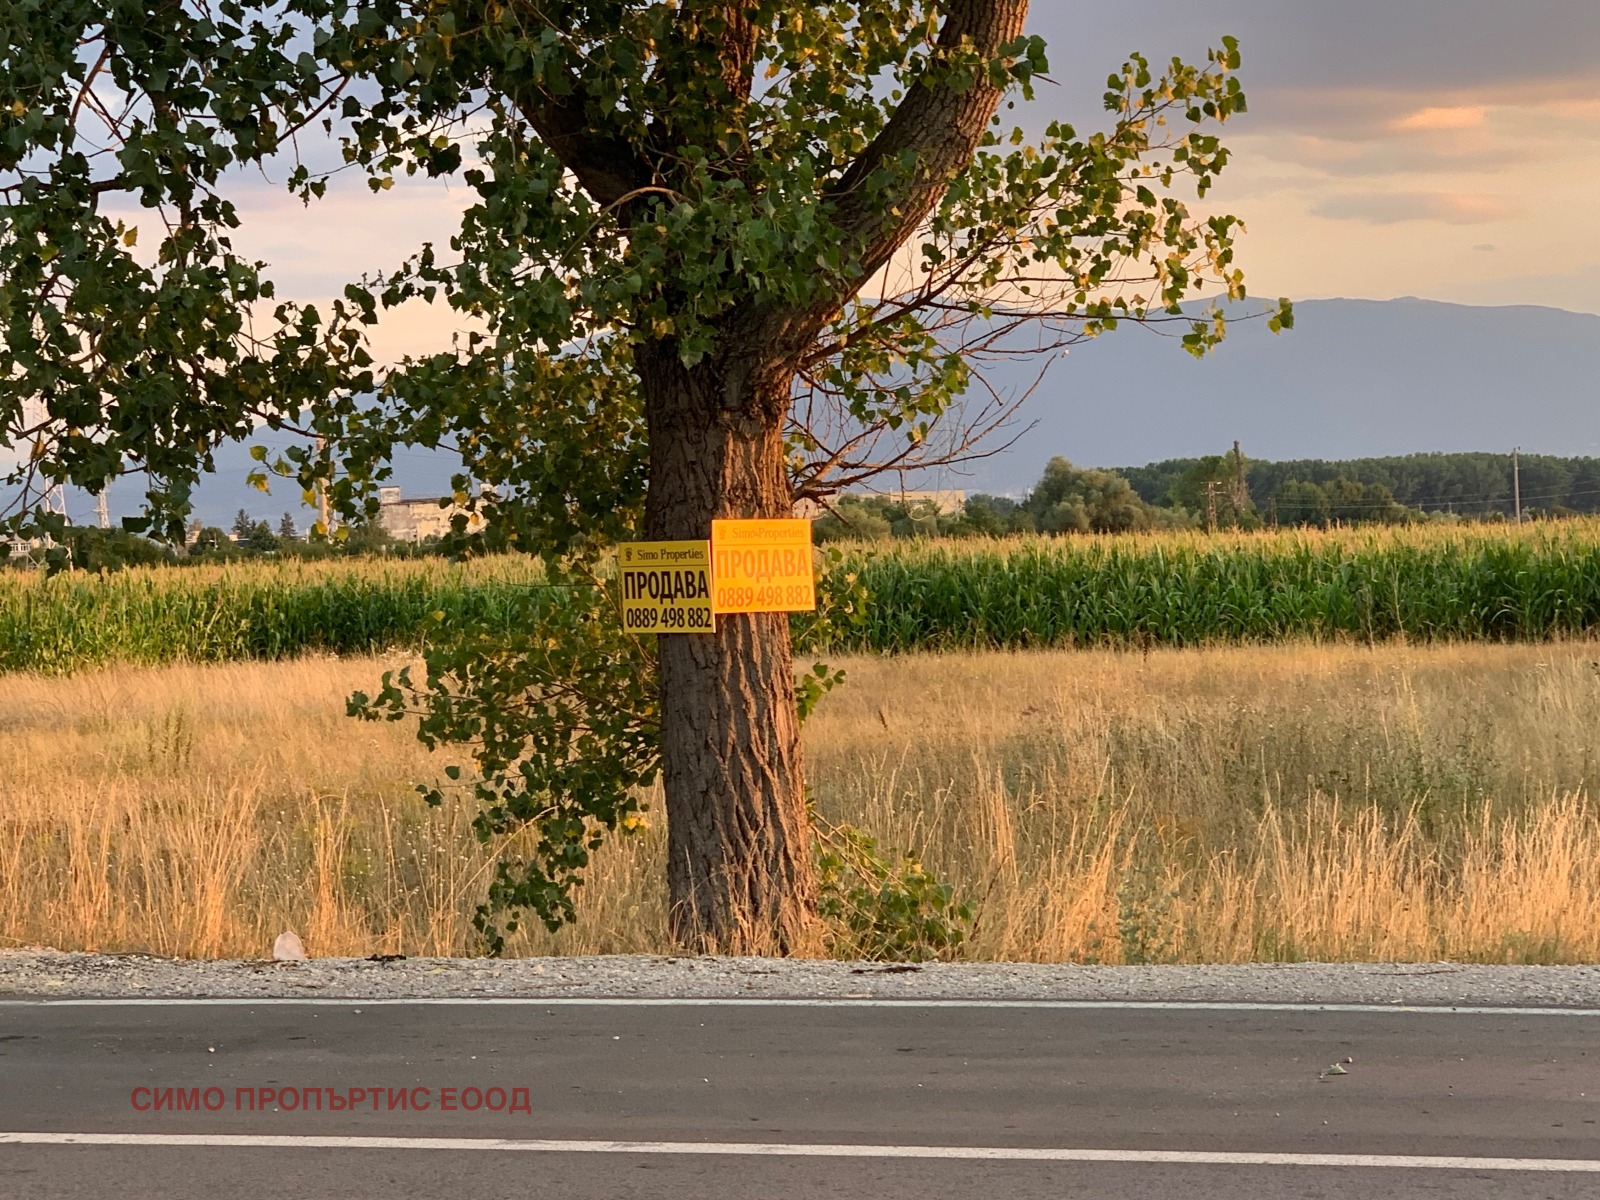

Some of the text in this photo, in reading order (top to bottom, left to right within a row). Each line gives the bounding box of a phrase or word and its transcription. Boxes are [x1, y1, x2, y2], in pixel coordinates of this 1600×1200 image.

[732, 527, 805, 541] Simo Properties
[637, 548, 704, 563] Simo Properties
[716, 549, 809, 583] ПРОДАВА
[624, 570, 709, 605] ПРОДАВА
[717, 584, 812, 608] 0889 498 882
[626, 607, 712, 628] 0889 498 882
